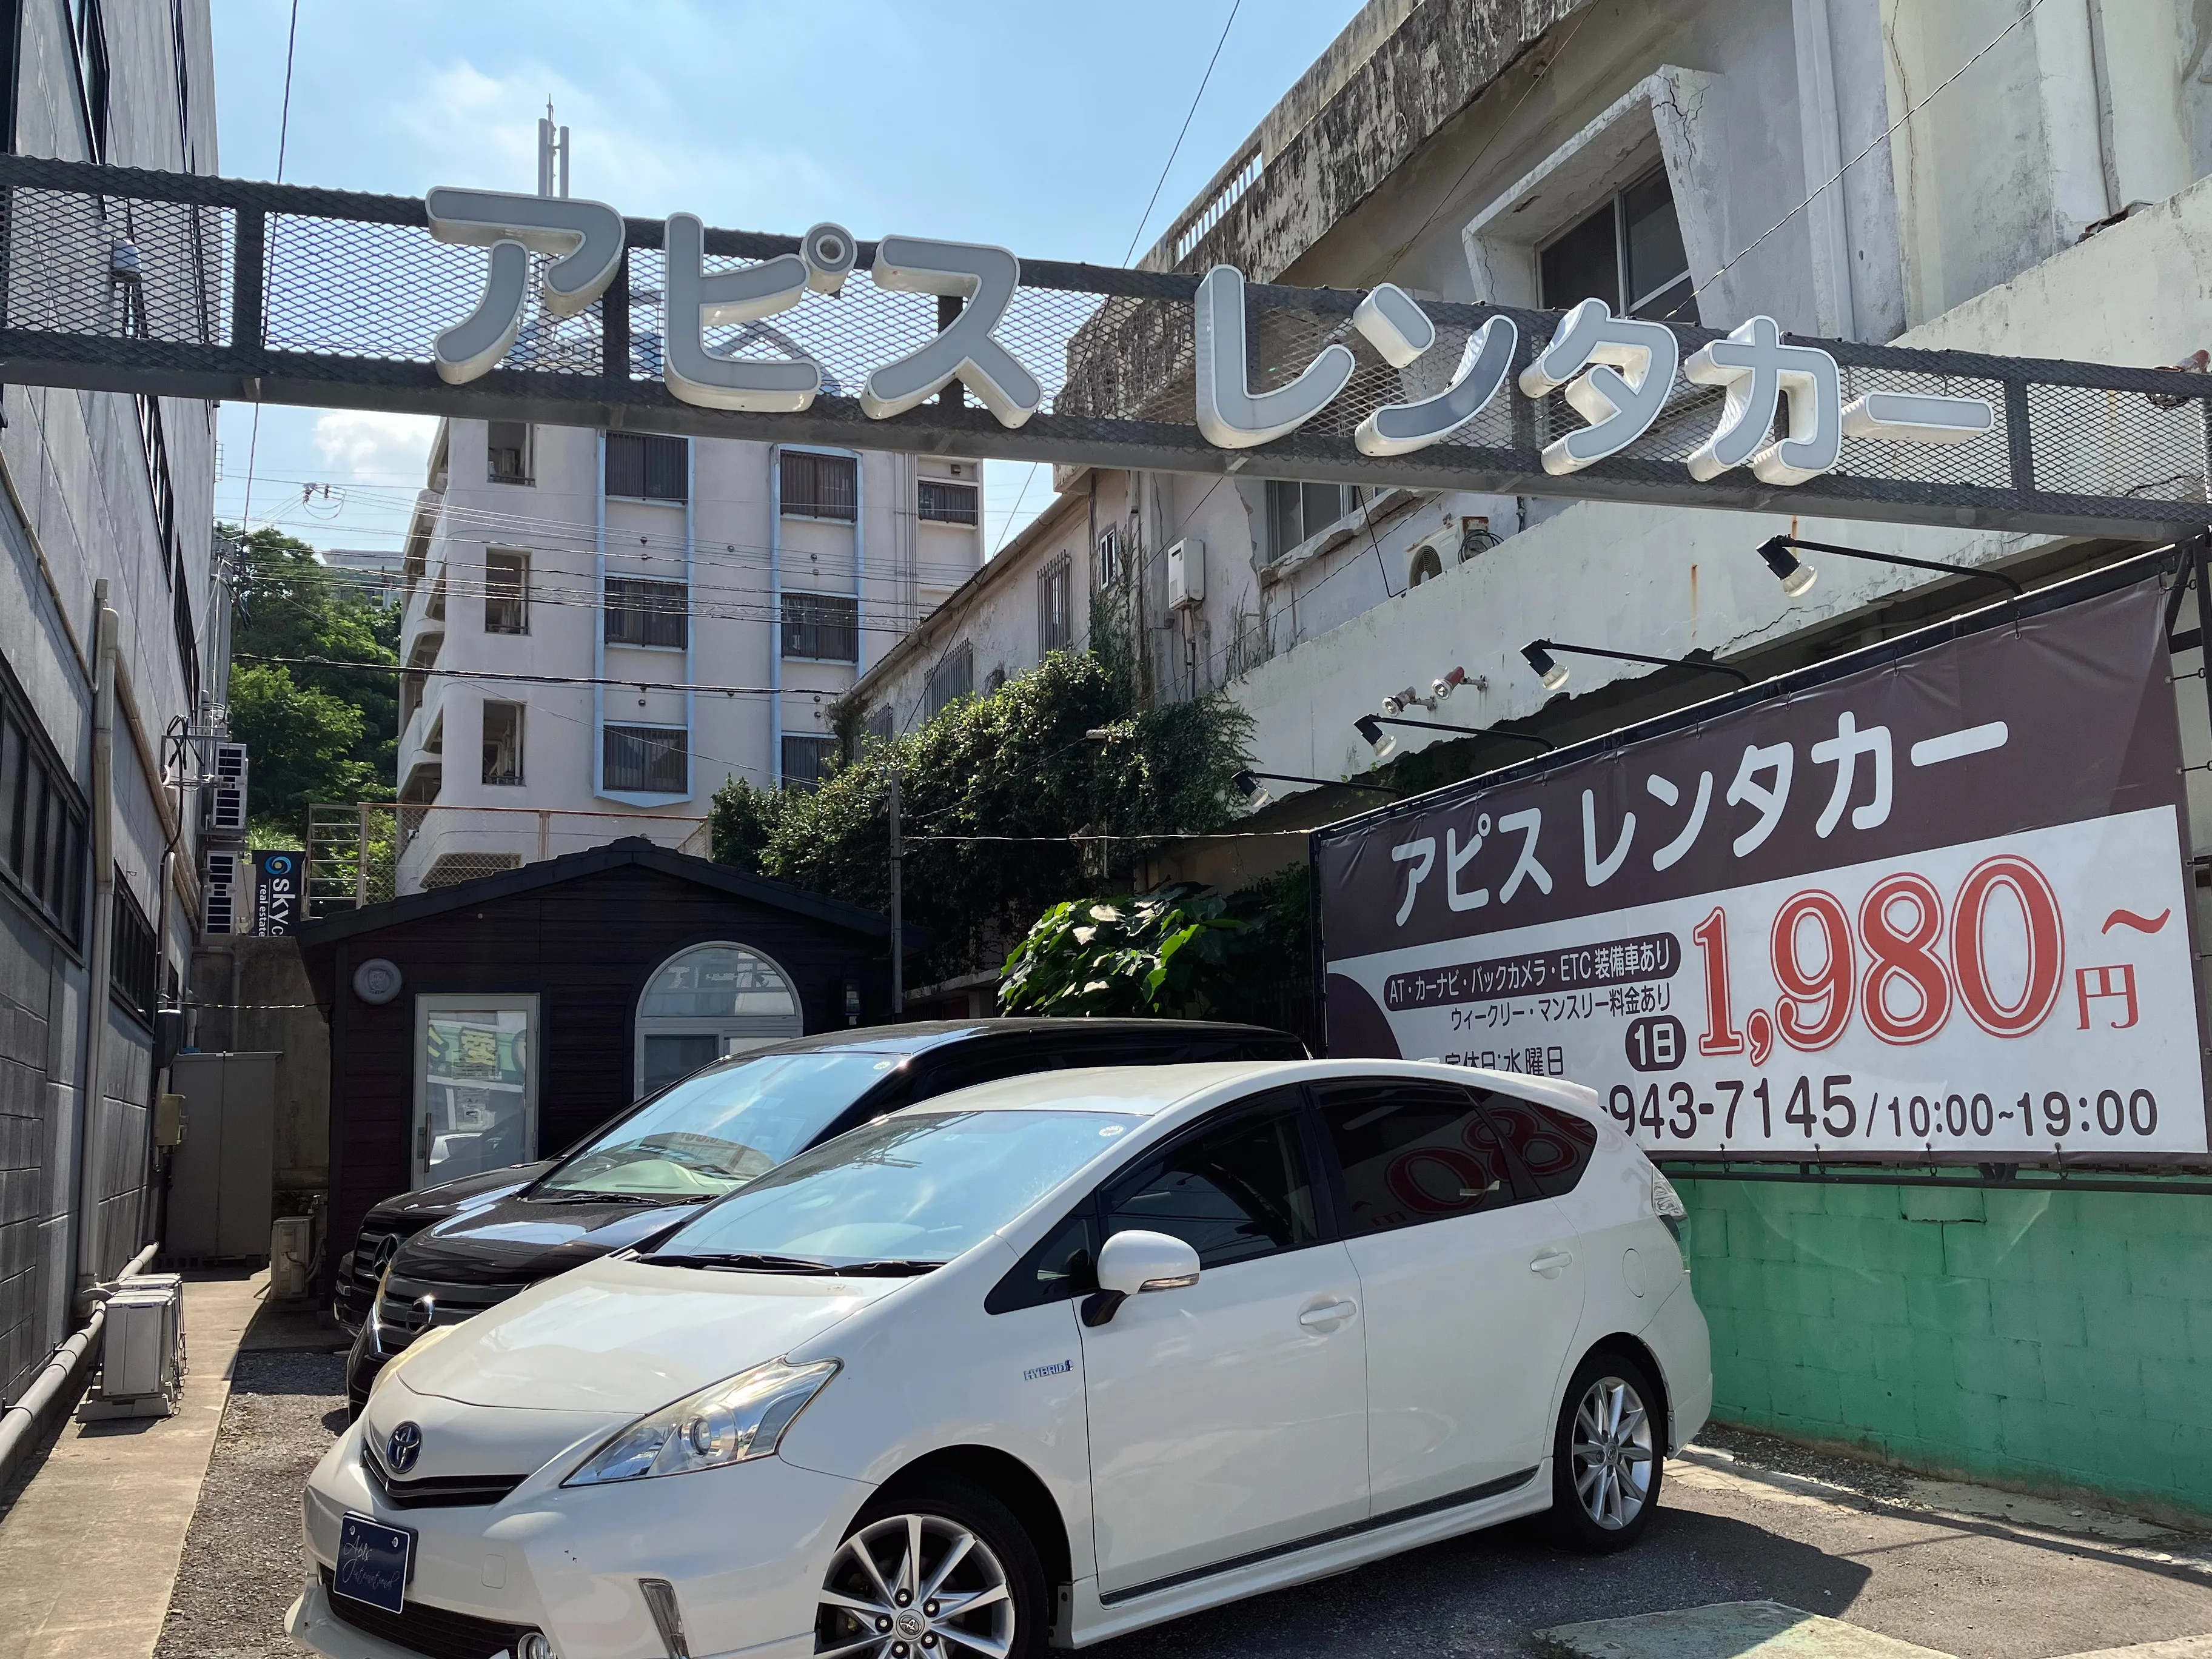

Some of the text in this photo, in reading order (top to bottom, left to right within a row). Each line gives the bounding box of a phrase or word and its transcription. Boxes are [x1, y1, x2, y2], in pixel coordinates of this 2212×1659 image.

[425, 185, 1995, 486] アピス レンタカー
[1391, 711, 2009, 927] アピス レンタカー
[258, 884, 269, 937] real estate
[1450, 982, 1671, 1031] ウィークリー・マンスリー料金あり
[1634, 1022, 1677, 1067] 1日
[1024, 1361, 1069, 1381] HYBRID
